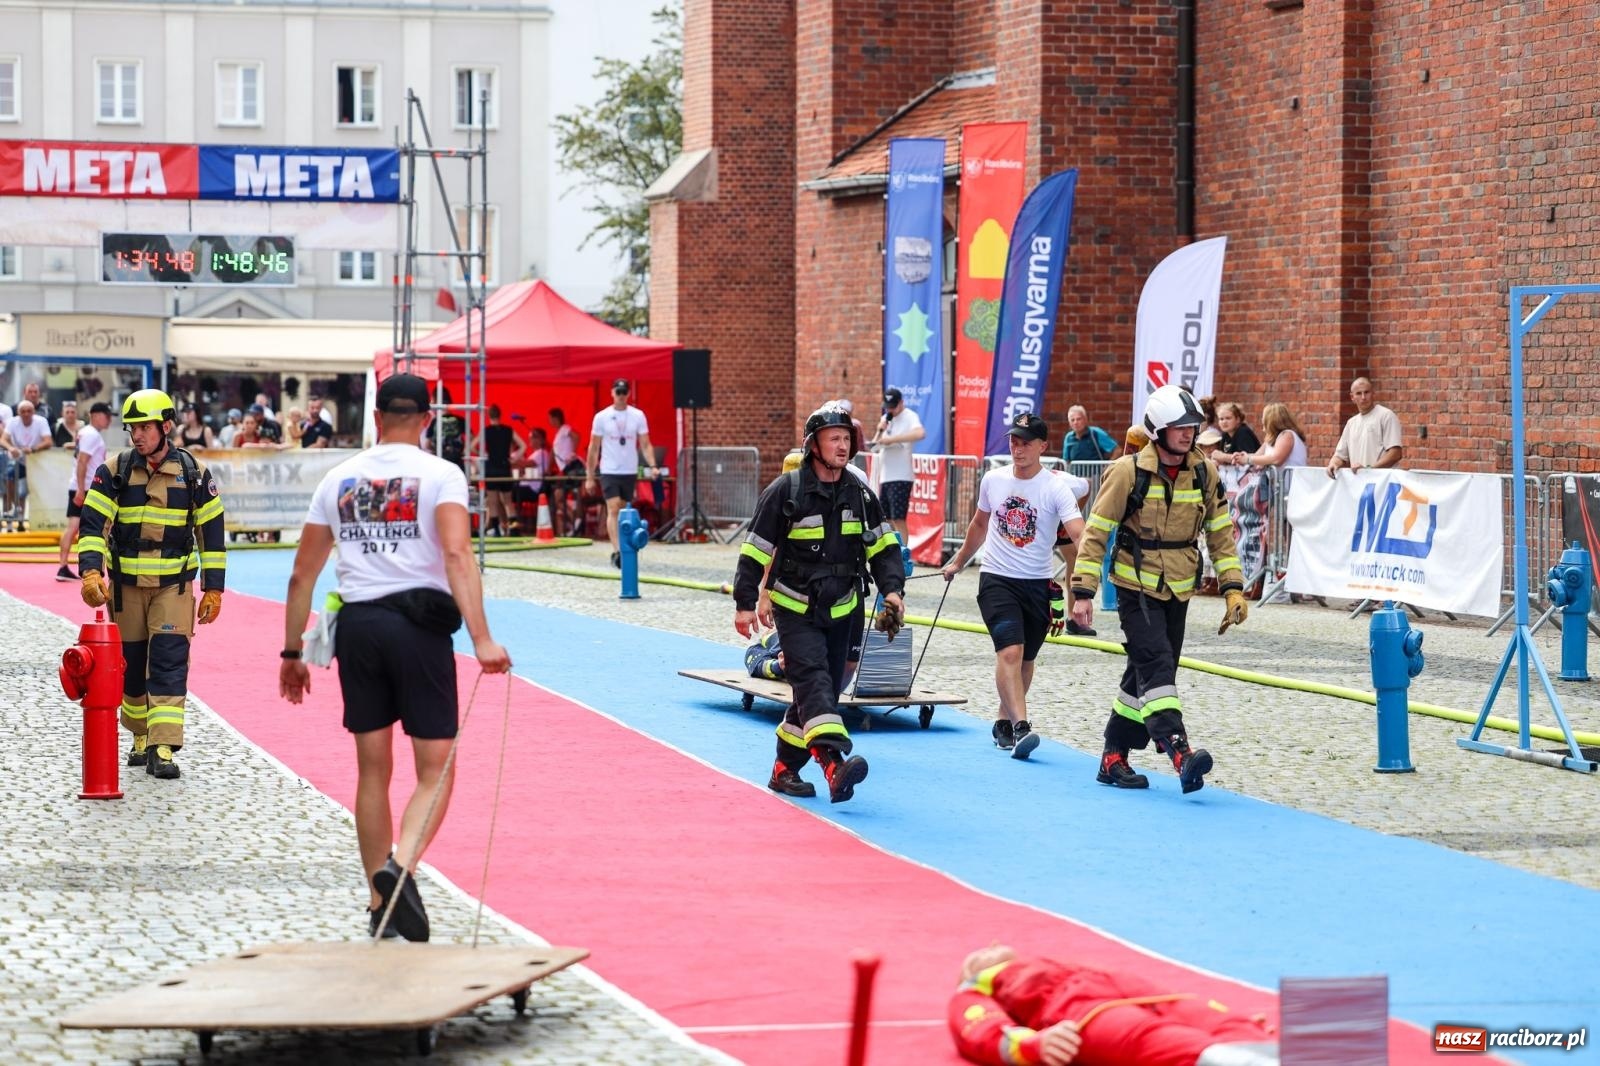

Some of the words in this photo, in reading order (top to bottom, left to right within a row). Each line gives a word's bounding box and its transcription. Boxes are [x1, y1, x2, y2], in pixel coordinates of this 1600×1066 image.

[23, 147, 168, 195] META
[234, 153, 375, 199] META
[115, 249, 195, 273] 1:34.48
[212, 251, 289, 274] 1:48.46
[1010, 235, 1052, 395] Husqvarna
[340, 525, 420, 540] CHALLENGE
[360, 541, 399, 554] 2017
